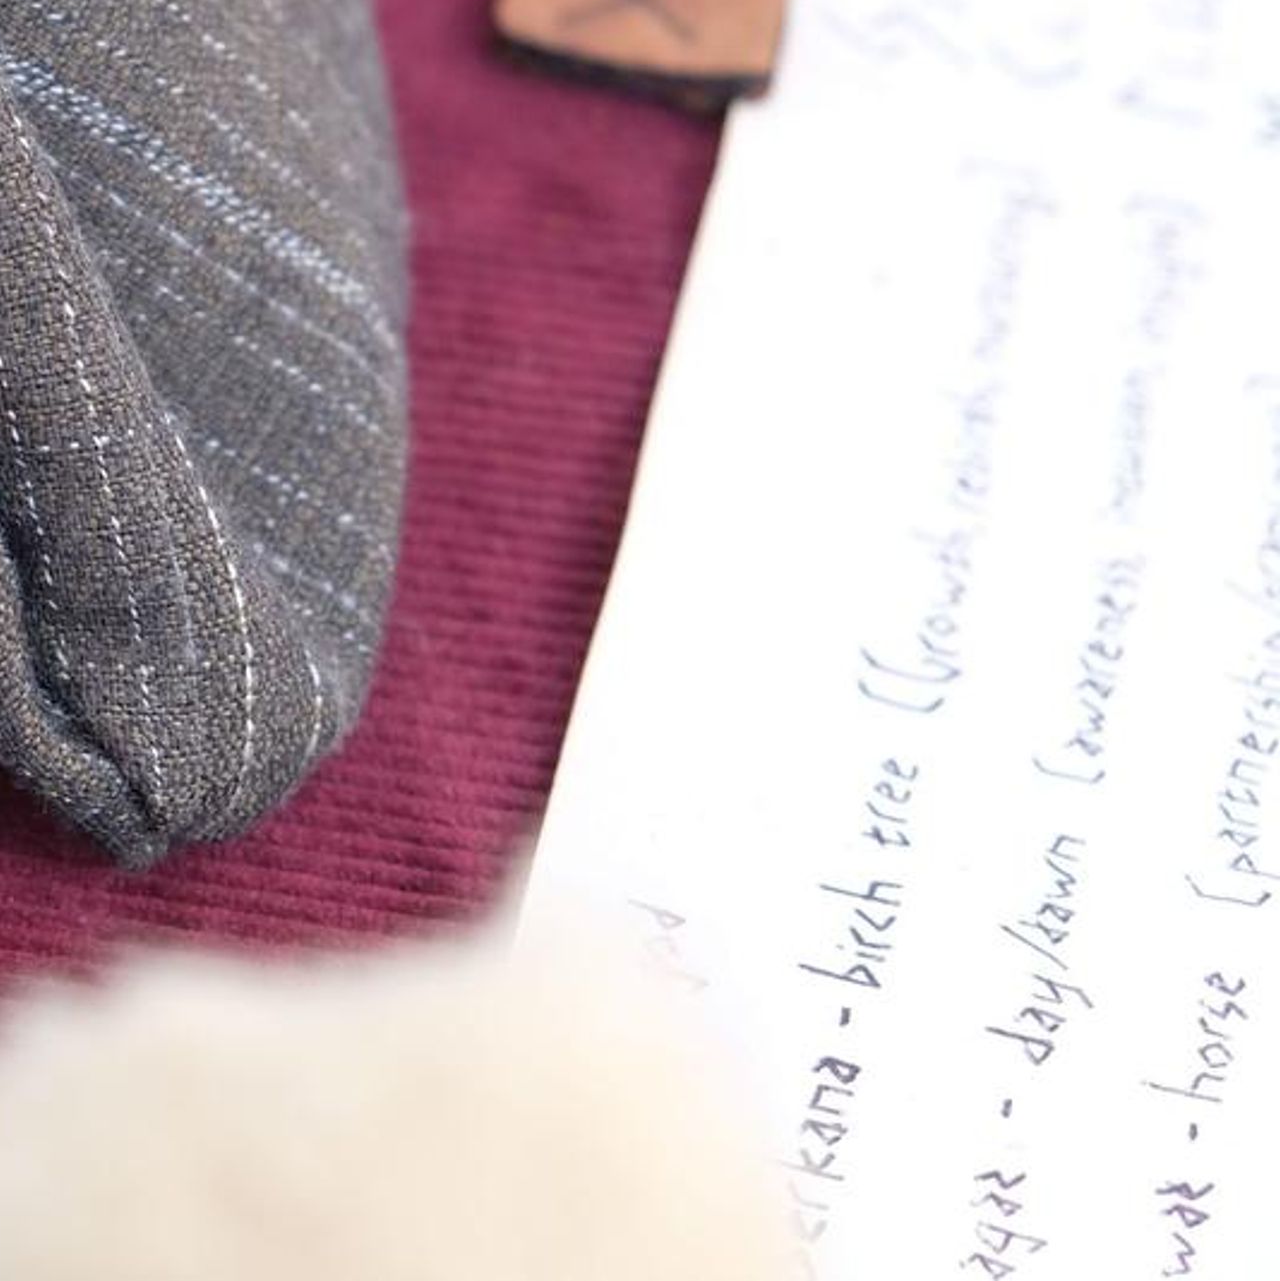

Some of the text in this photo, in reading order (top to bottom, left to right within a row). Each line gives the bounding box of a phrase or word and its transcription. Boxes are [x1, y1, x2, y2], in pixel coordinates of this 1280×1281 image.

[797, 878, 905, 990] birch
[861, 756, 920, 849] tree
[1140, 970, 1250, 1104] horse
